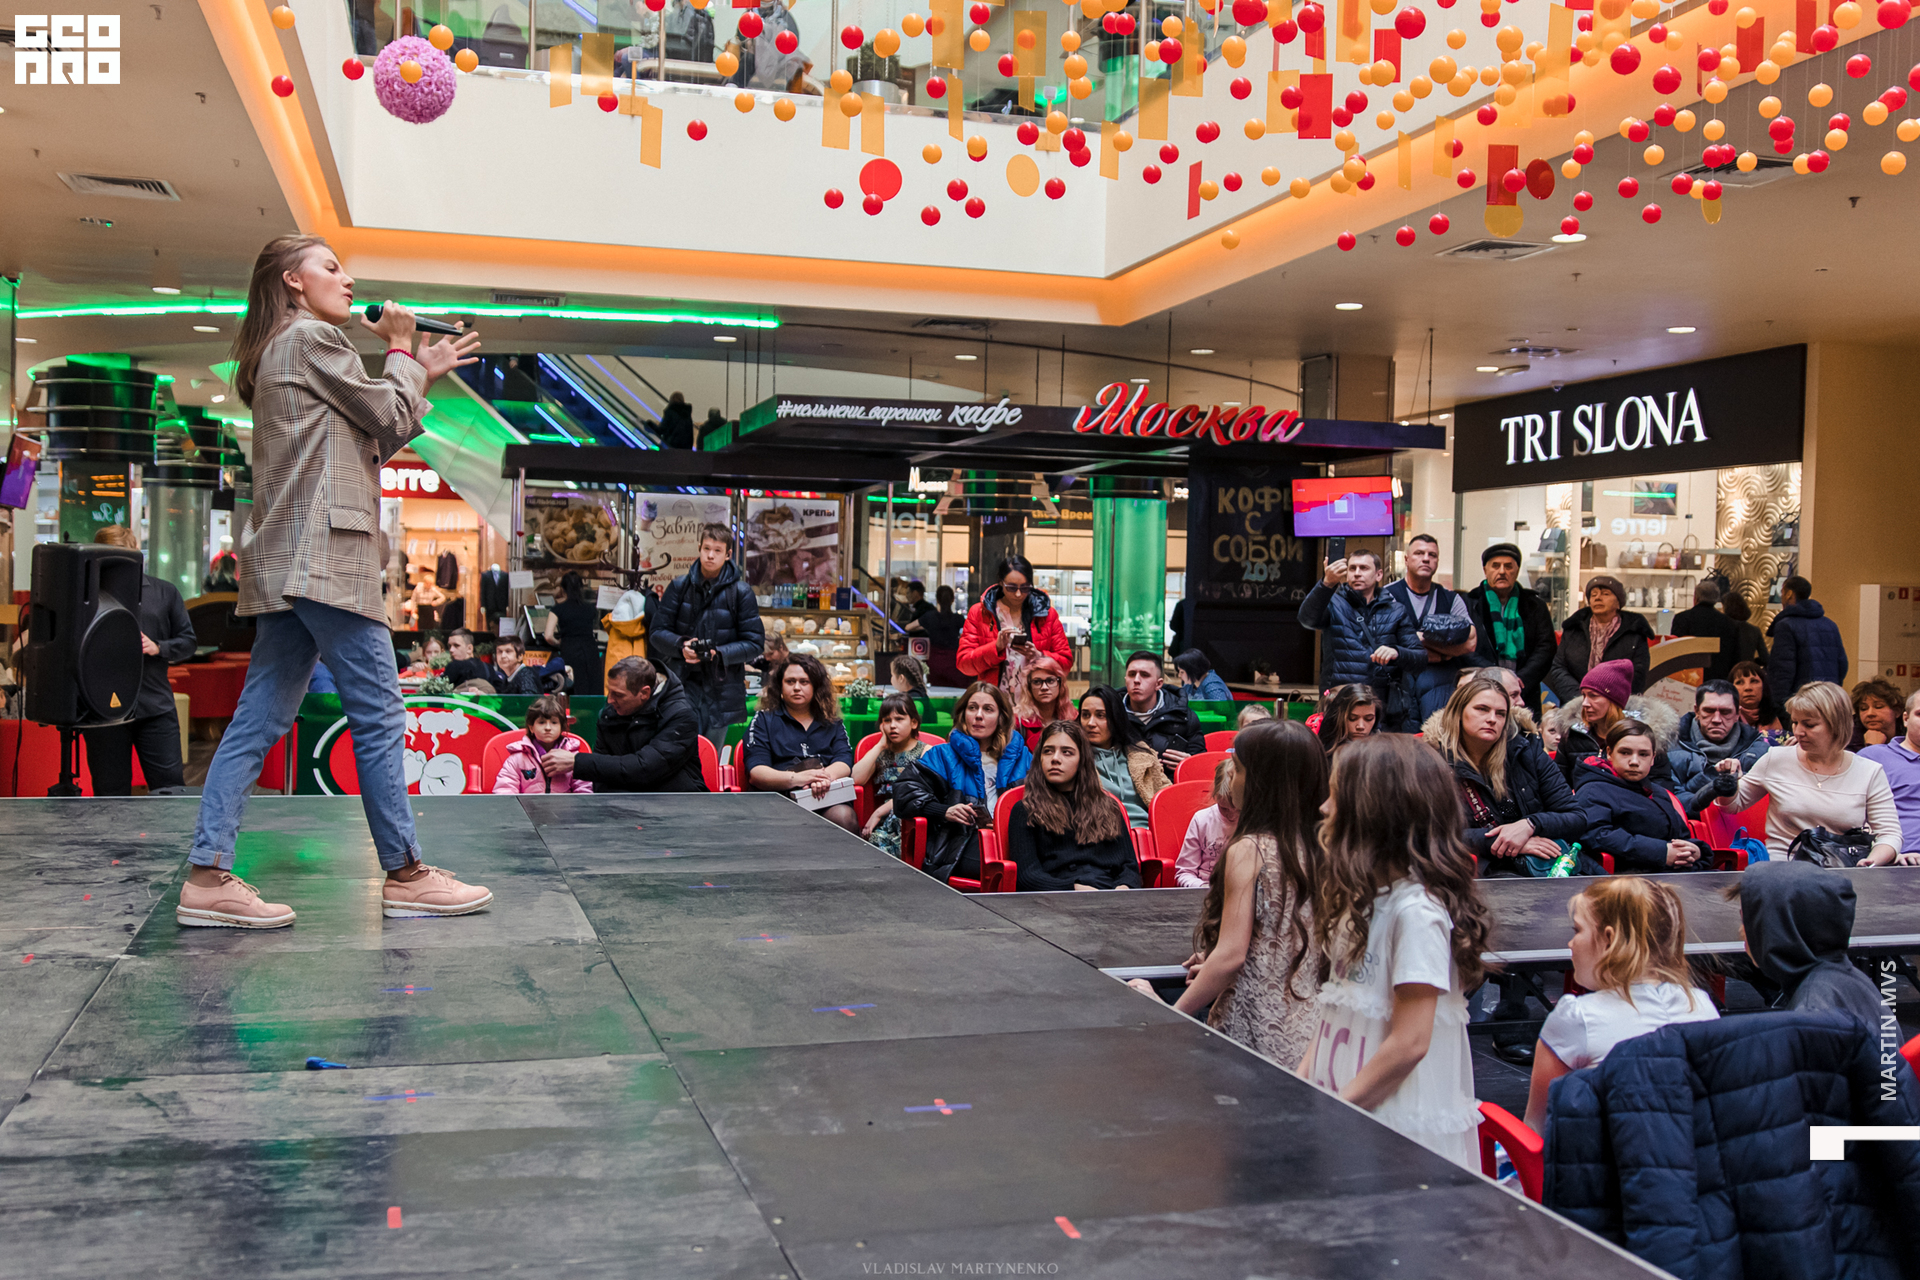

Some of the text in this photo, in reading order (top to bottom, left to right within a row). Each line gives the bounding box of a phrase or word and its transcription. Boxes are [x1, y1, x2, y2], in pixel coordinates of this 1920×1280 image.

[776, 397, 1022, 432] #пельмени_вареники кафе
[1073, 382, 1305, 446] Москва
[1500, 387, 1709, 465] TRI SLONA
[1245, 511, 1262, 535] С
